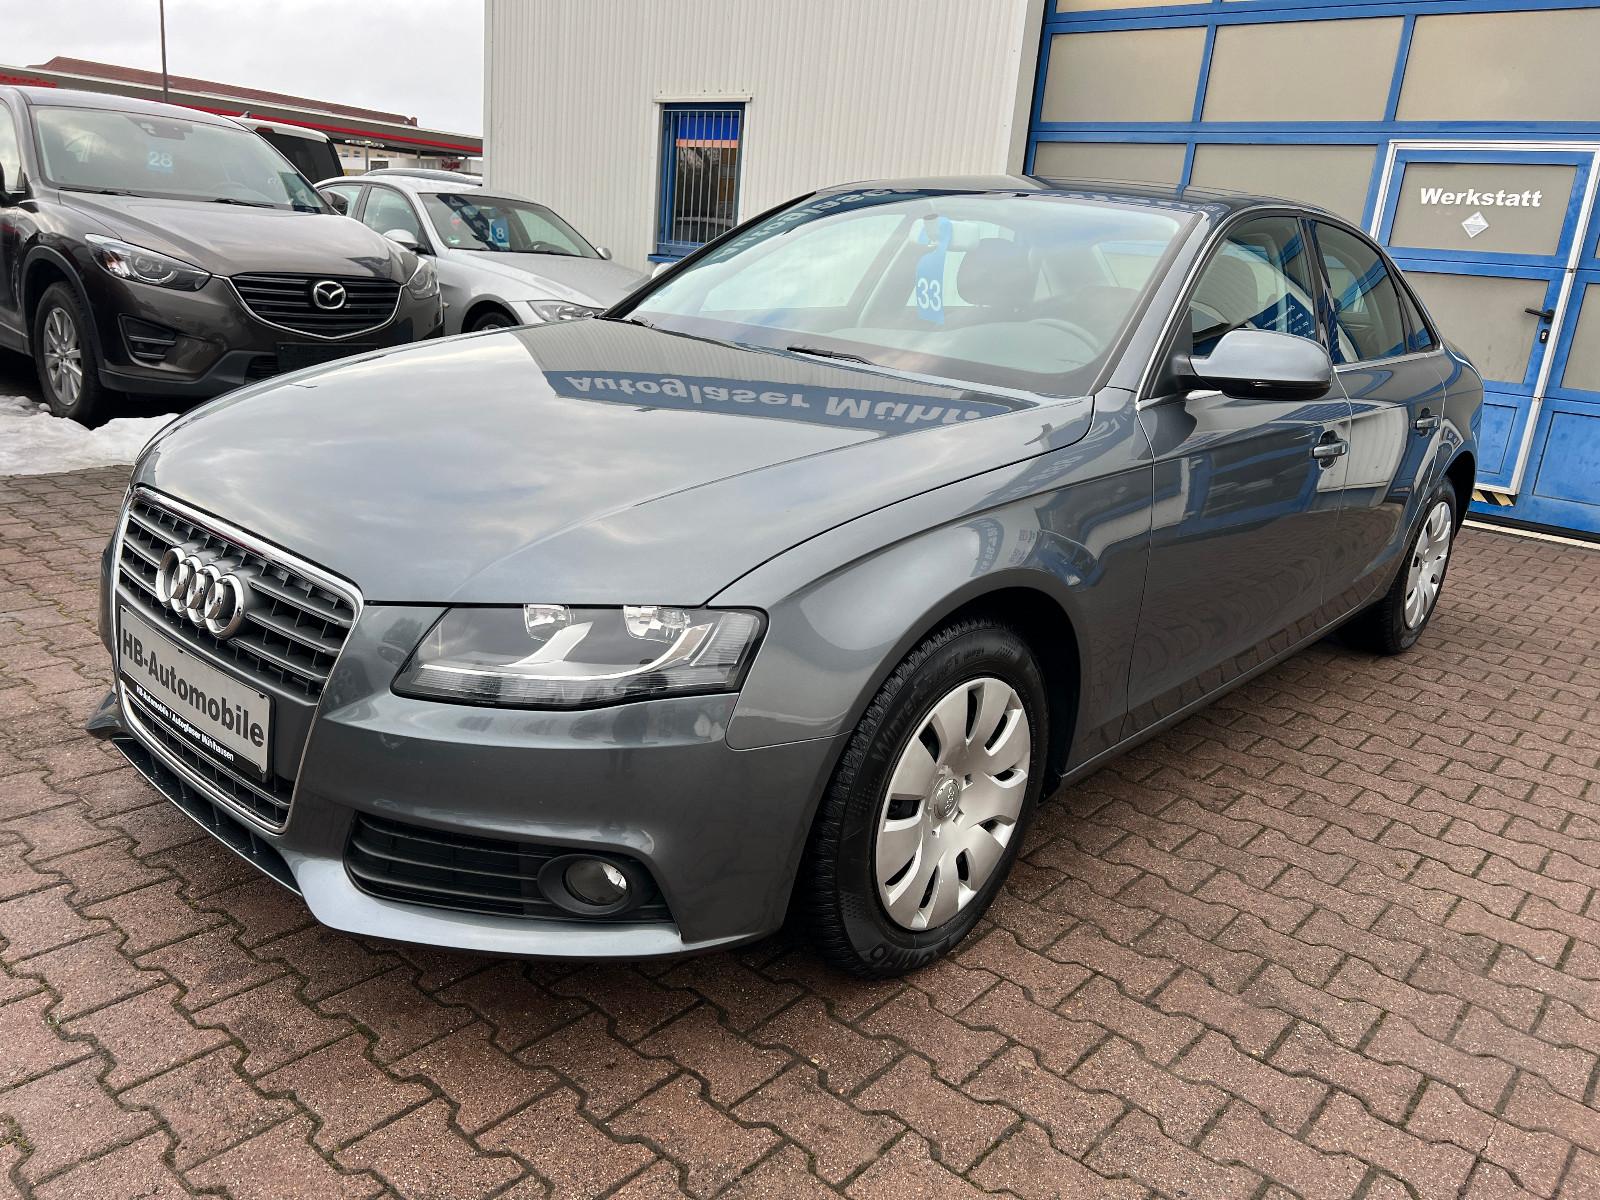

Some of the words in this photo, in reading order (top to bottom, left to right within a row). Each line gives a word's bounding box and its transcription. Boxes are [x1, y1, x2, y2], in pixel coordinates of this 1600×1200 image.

[148, 151, 173, 168] 28
[1420, 187, 1543, 207] Werkstatt
[917, 277, 942, 312] 33
[122, 629, 265, 748] HB-Automobile
[201, 733, 234, 762] Mühlhausen
